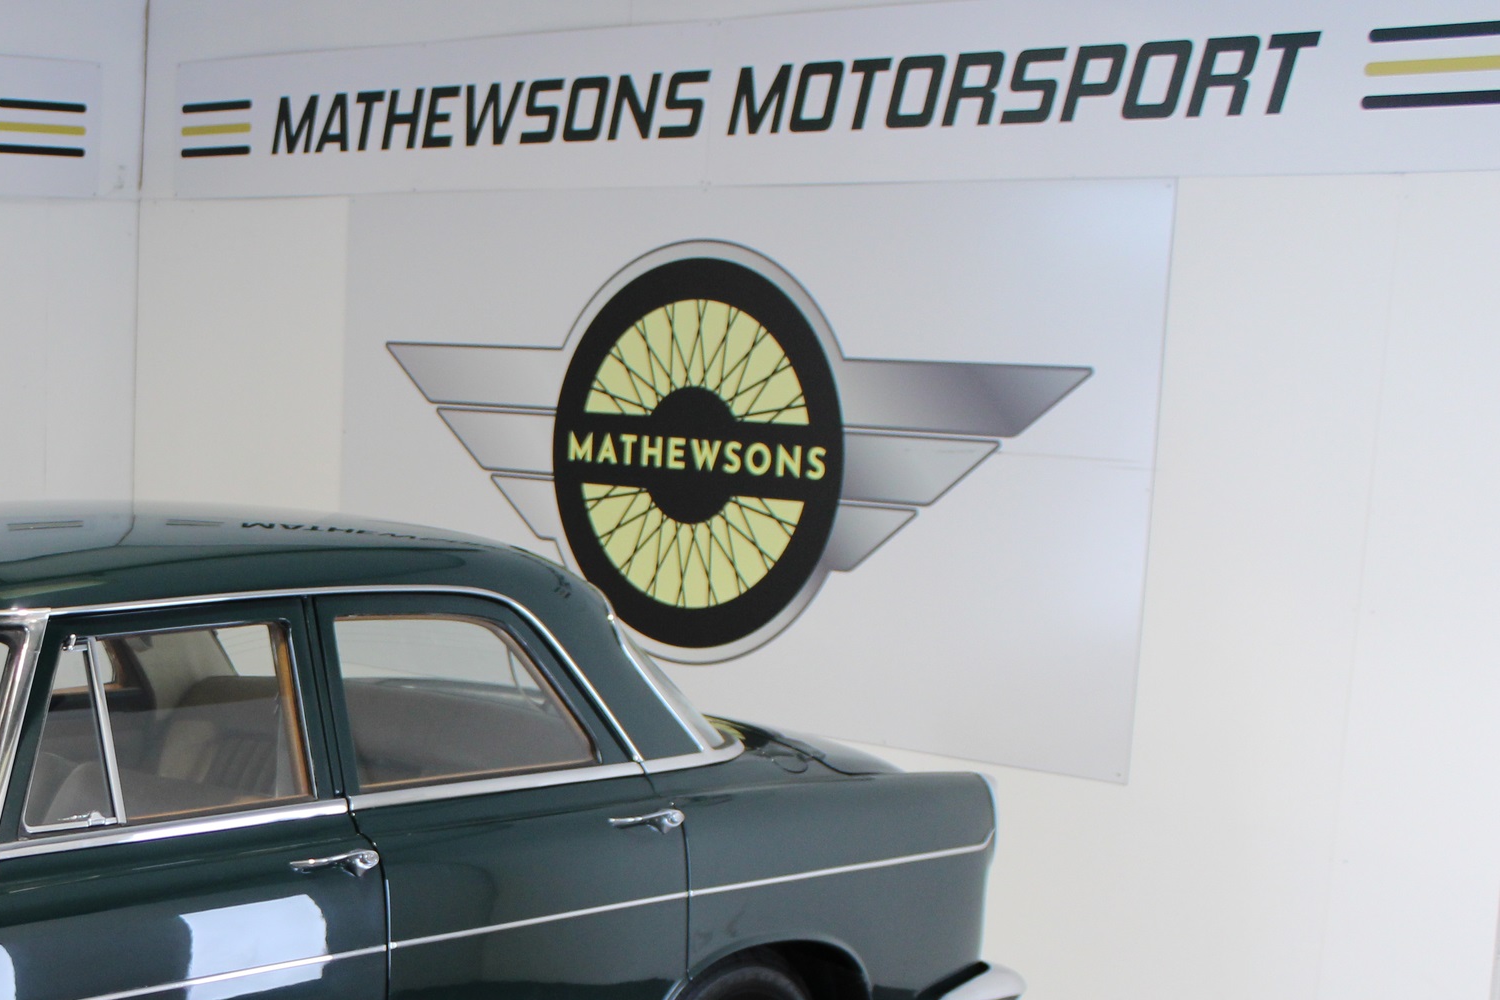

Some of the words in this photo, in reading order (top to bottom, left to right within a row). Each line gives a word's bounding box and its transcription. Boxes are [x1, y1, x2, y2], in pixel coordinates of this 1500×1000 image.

[271, 69, 711, 155] MATHEWSONS
[727, 30, 1322, 136] MOTORSPORT
[567, 431, 828, 481] MATHEWSONS
